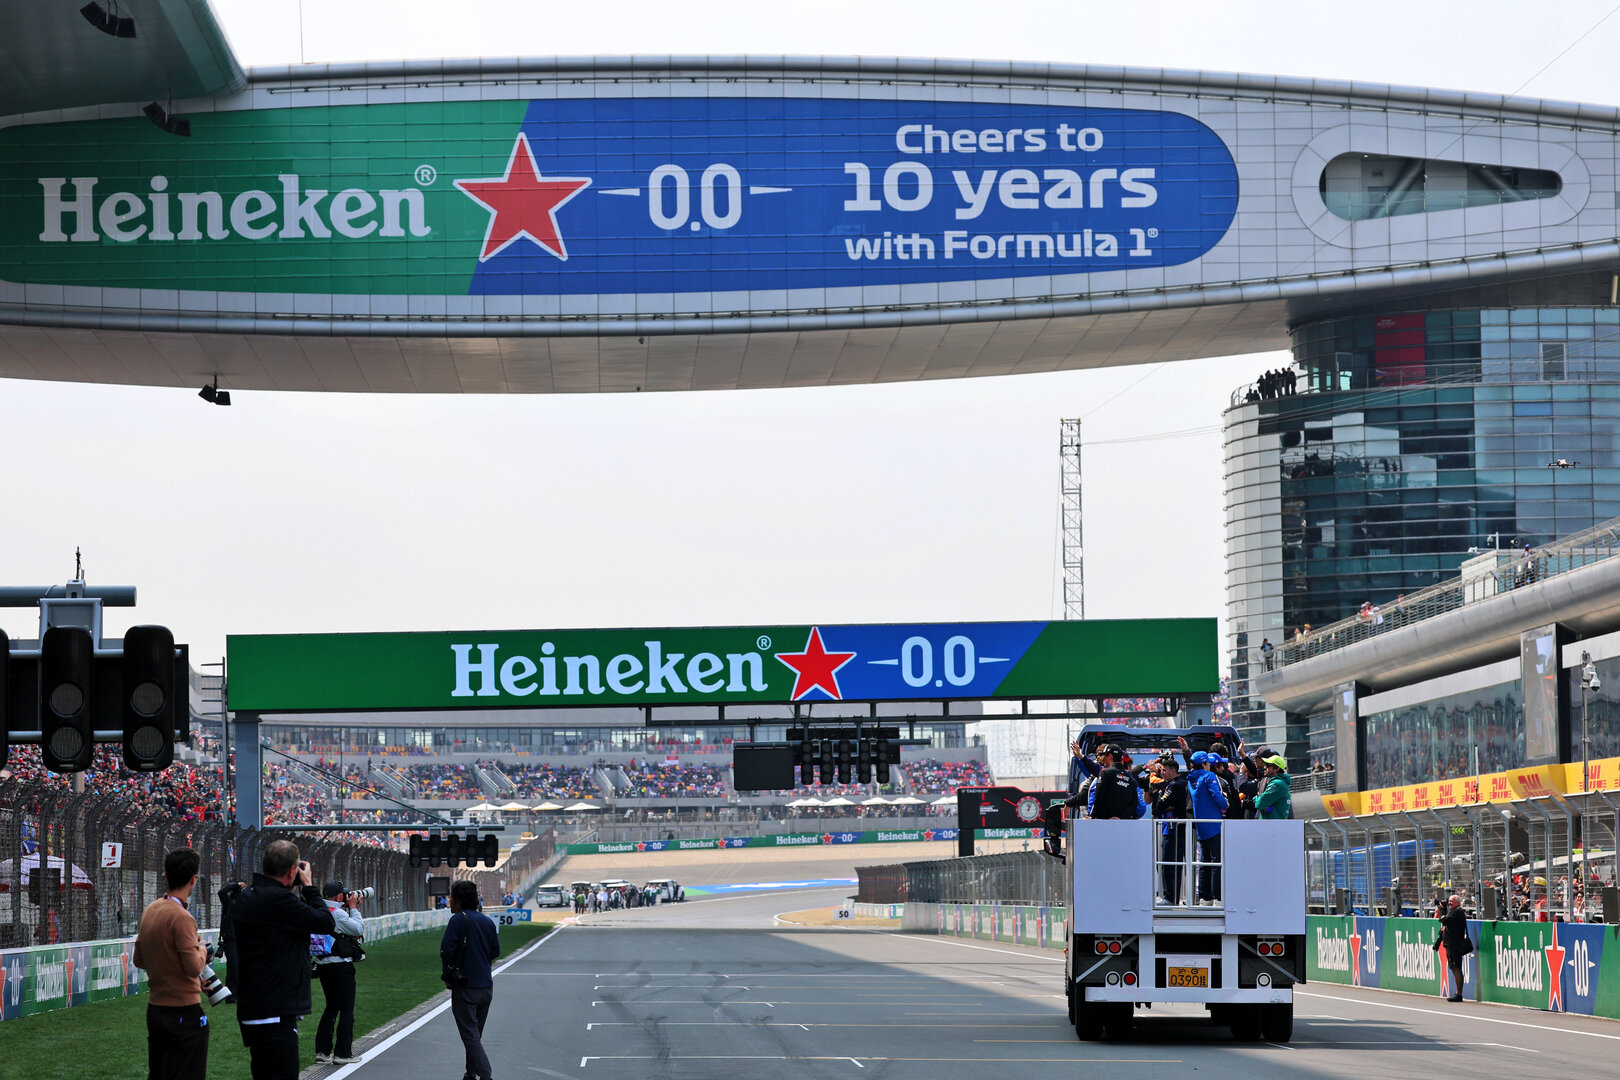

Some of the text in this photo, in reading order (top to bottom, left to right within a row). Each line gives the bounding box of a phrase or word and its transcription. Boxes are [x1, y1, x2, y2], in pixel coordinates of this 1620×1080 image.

[896, 123, 1104, 154] Cheers to
[648, 163, 742, 232] 0.0
[843, 161, 1158, 220] 10 years
[845, 231, 936, 261] with
[944, 228, 1118, 260] Formula
[901, 634, 976, 687] 0.0
[839, 910, 849, 918] 50
